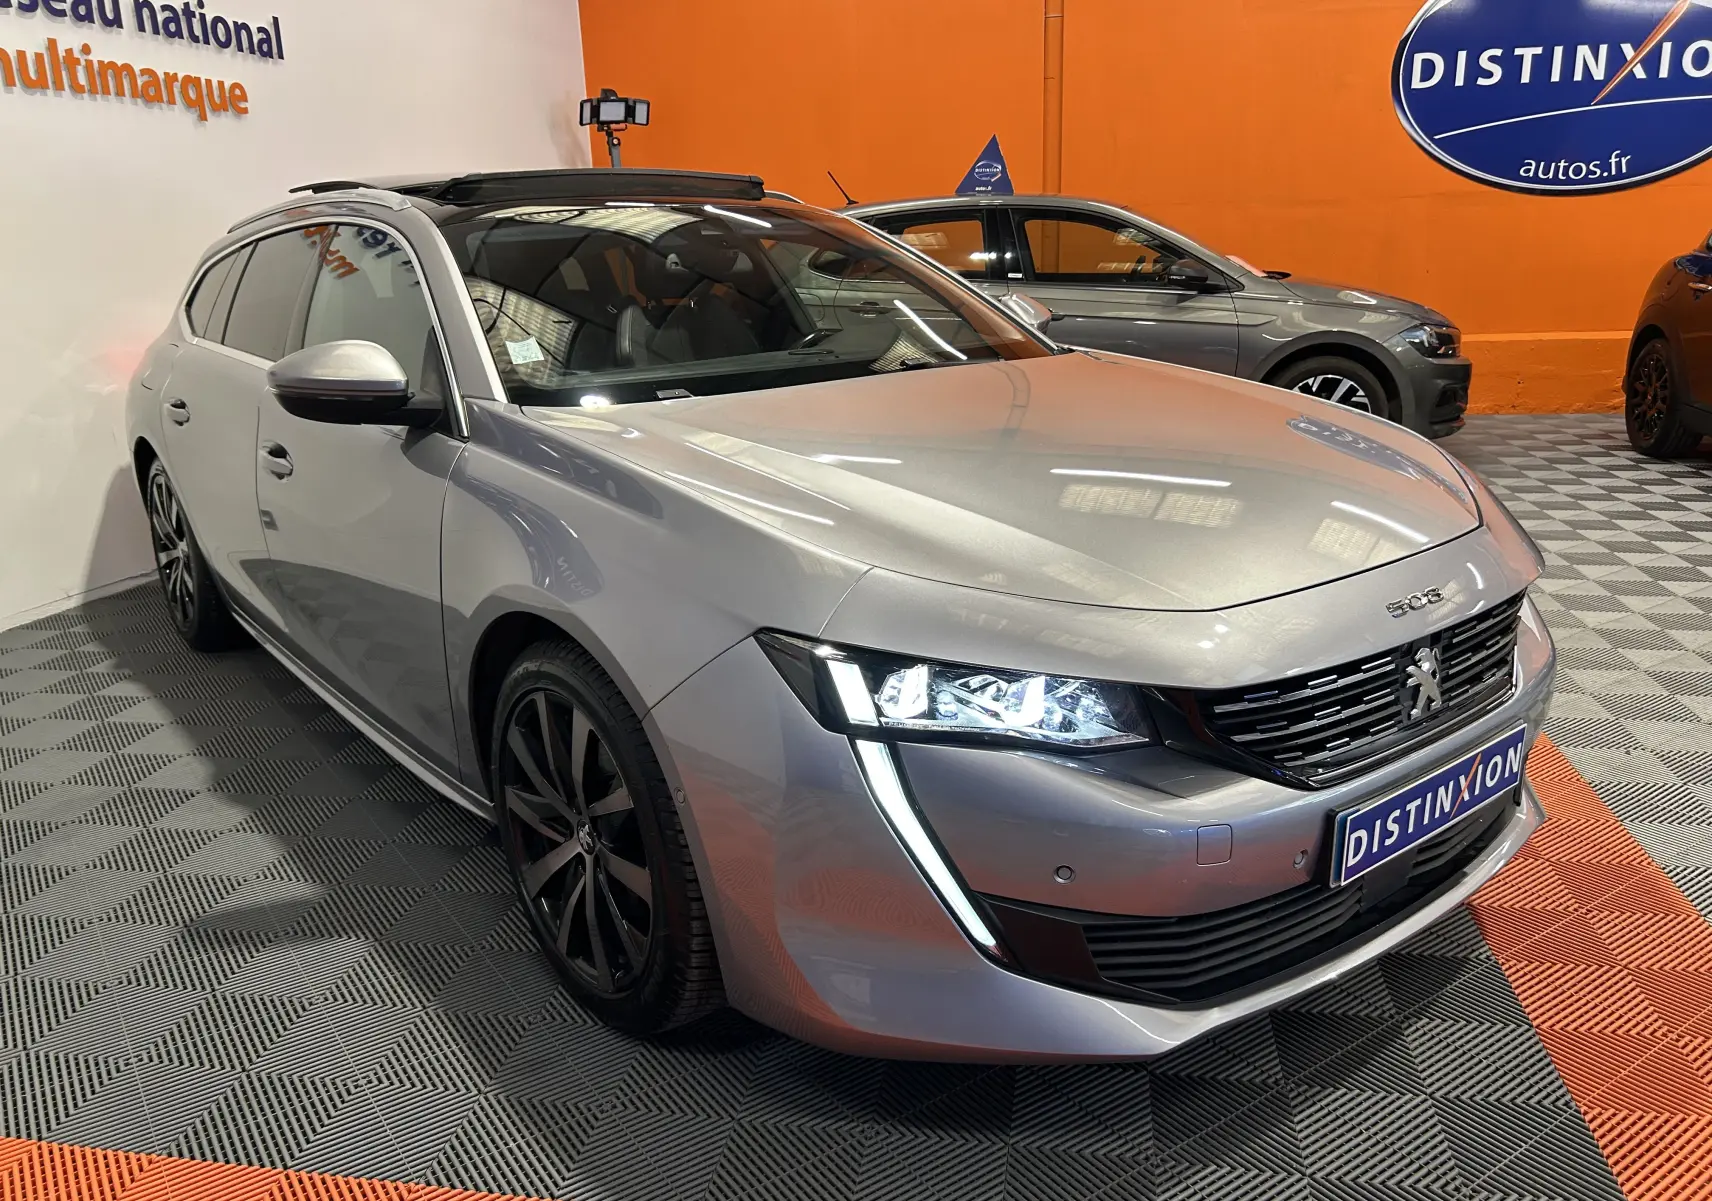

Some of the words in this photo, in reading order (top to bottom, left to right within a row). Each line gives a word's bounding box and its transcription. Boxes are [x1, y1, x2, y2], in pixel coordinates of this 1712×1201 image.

[133, 0, 284, 60] national
[1519, 150, 1631, 180] autos.fr
[1385, 586, 1445, 619] 508
[1347, 742, 1523, 868] DISTINXION
